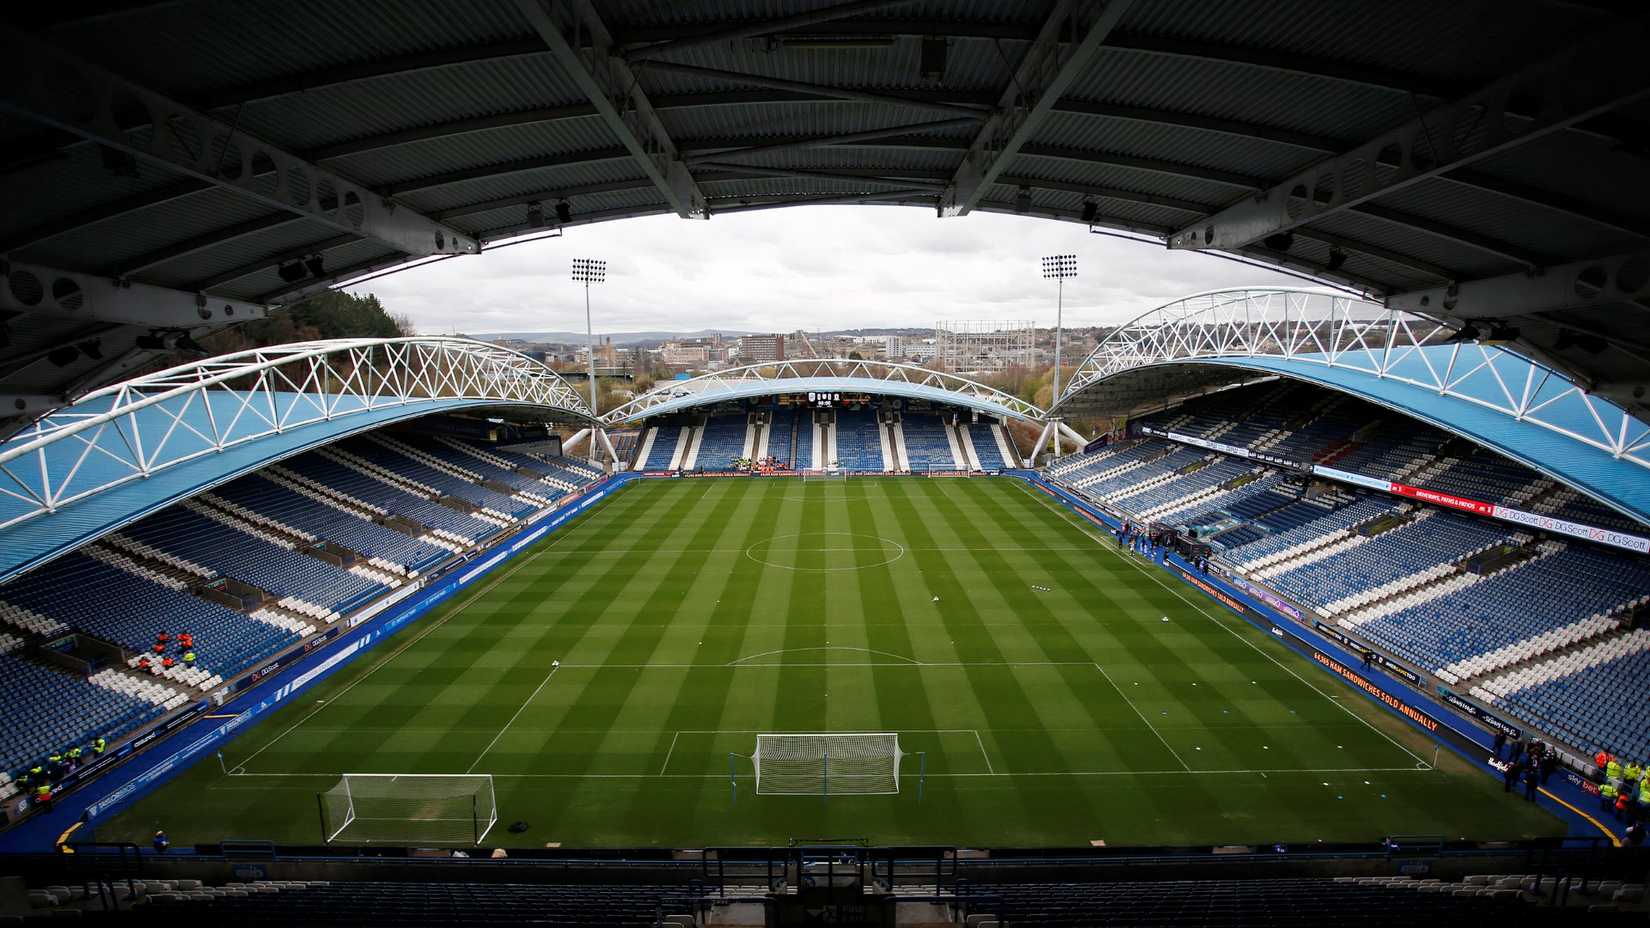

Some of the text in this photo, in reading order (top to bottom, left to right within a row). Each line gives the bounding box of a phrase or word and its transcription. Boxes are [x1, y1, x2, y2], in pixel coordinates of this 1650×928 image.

[1328, 659, 1343, 675] HAM
[1343, 669, 1381, 697] SANDWICHES
[1381, 692, 1398, 708] SOLD
[1399, 705, 1438, 731] ANNUALLY
[1567, 774, 1598, 793] sky bet
